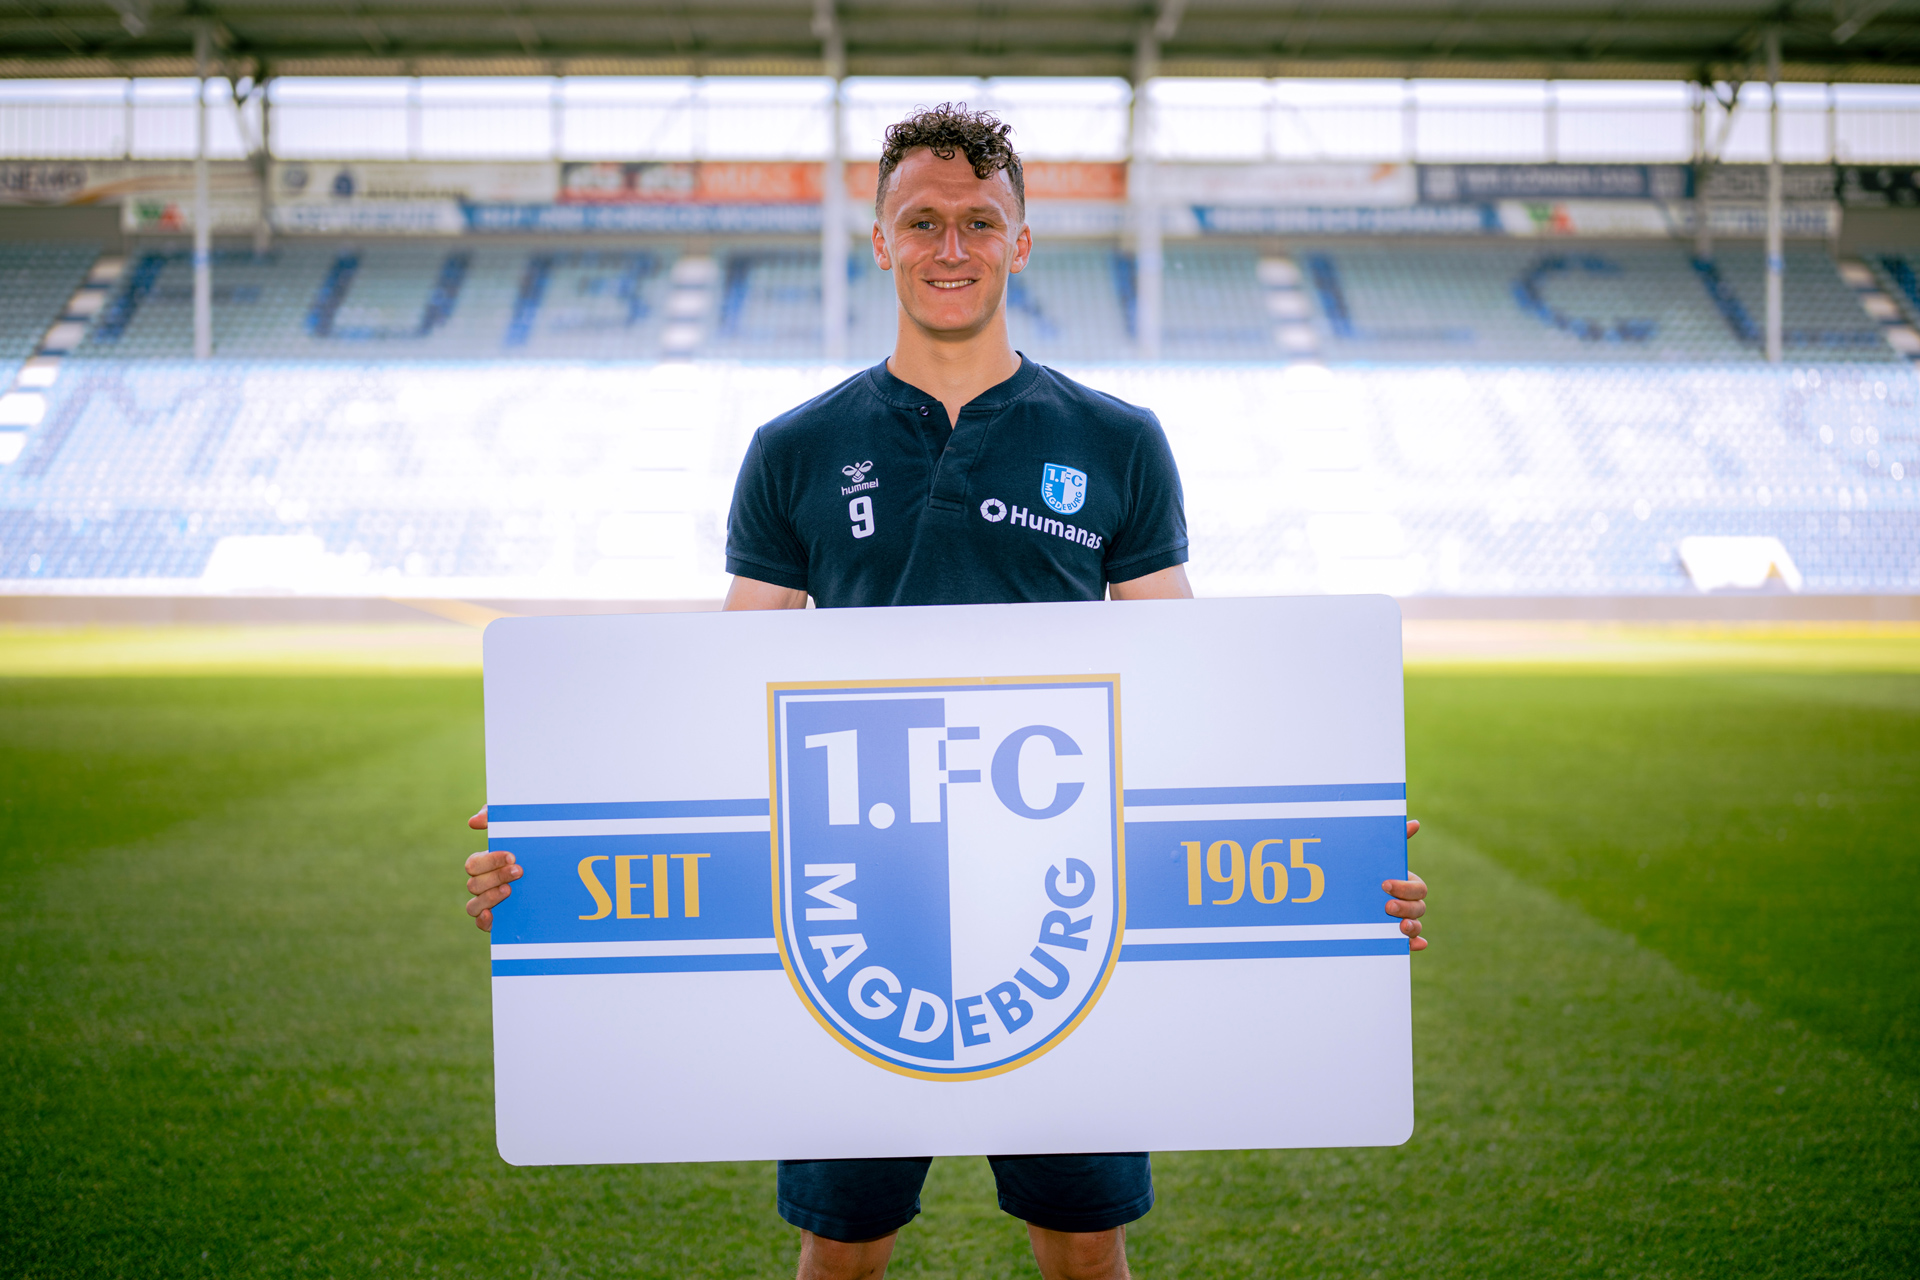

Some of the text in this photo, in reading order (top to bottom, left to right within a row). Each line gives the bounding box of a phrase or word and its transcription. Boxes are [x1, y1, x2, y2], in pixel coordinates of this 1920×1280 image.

[841, 478, 879, 496] hummel
[1045, 482, 1082, 511] MAGDEBURG
[849, 495, 875, 539] 9
[1010, 505, 1102, 549] Humanas
[577, 853, 711, 920] SEIT
[1180, 838, 1325, 905] 1965
[804, 857, 1096, 1048] MAGDEBURG
